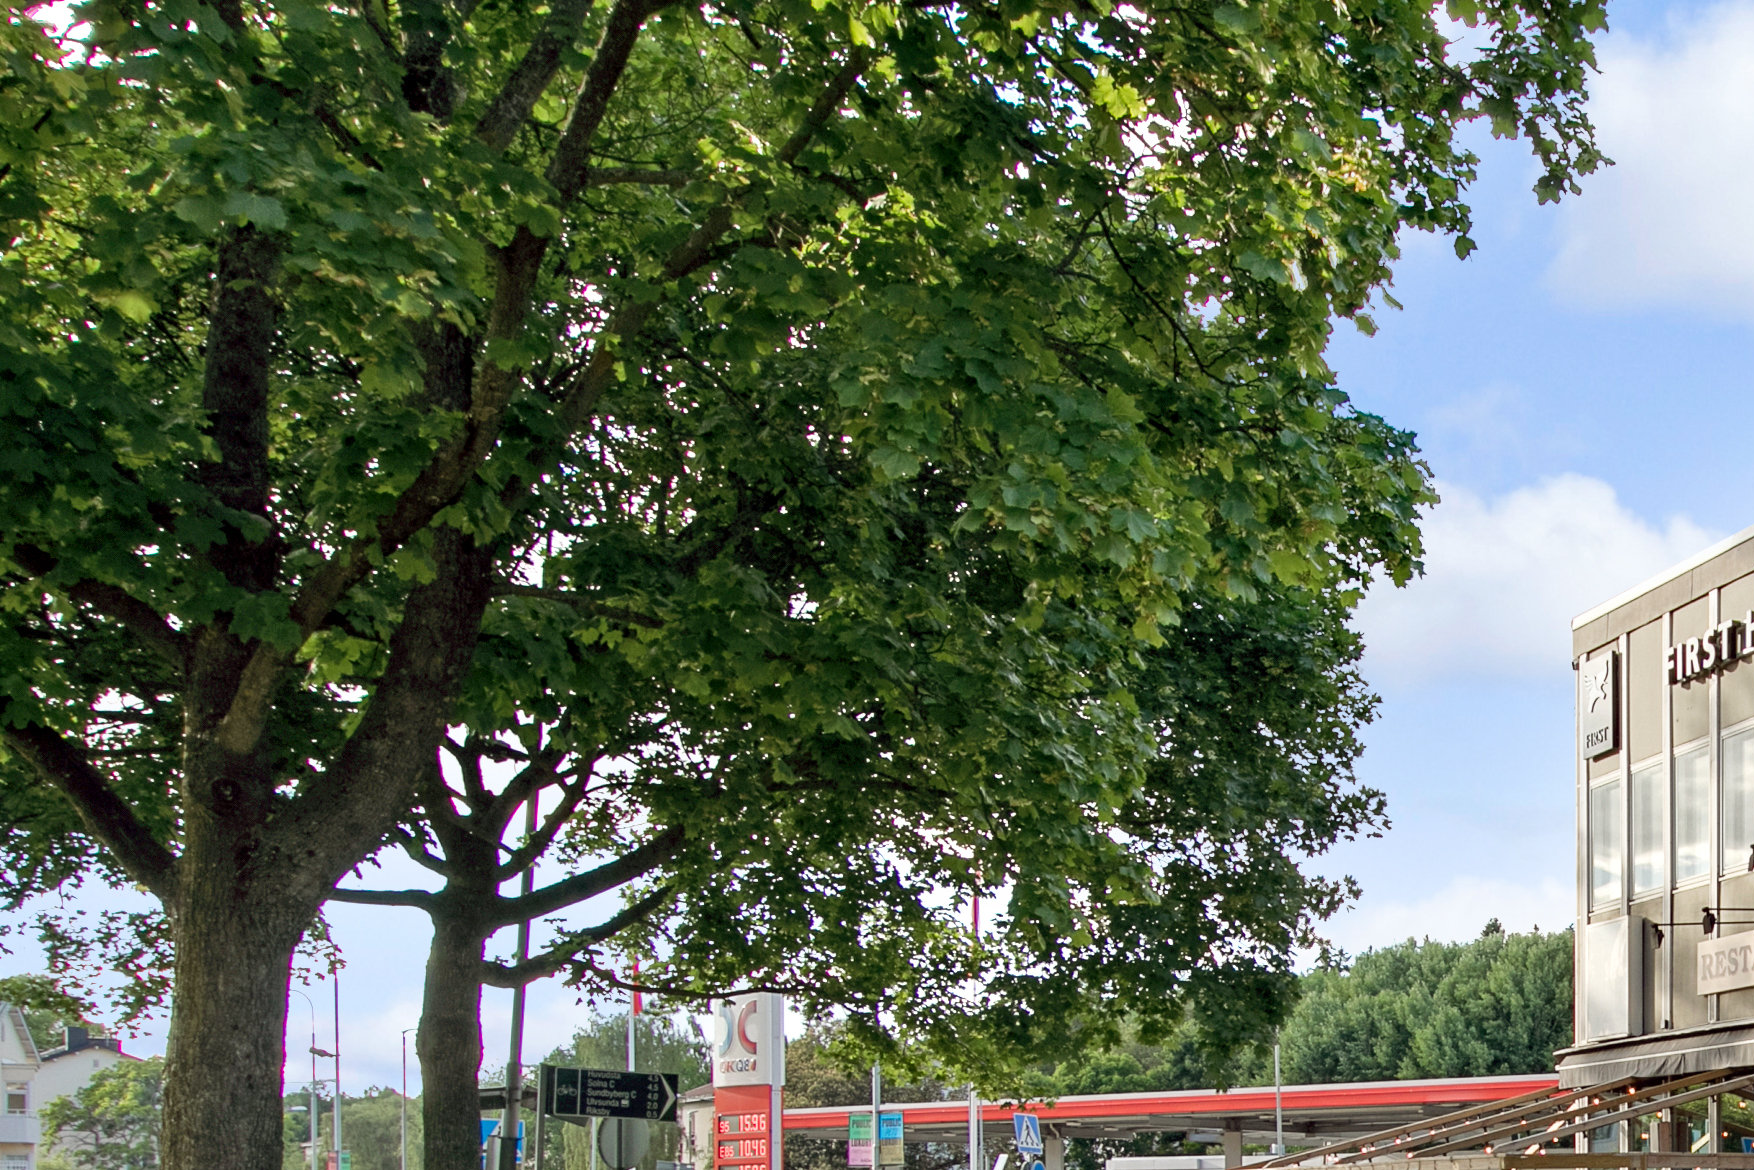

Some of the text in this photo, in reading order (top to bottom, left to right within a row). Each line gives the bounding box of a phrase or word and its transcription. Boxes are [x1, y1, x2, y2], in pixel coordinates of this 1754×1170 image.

[1665, 618, 1735, 686] FIRST
[1586, 726, 1609, 749] FIRST
[587, 1079, 608, 1088] Solna
[609, 1080, 616, 1088] C
[587, 1088, 630, 1099] Sundbyberg
[631, 1091, 637, 1099] C
[586, 1098, 619, 1107] Ulvsunda
[586, 1106, 610, 1116] Riksby
[719, 1121, 730, 1133] 95
[719, 1139, 767, 1158] E85 10.46
